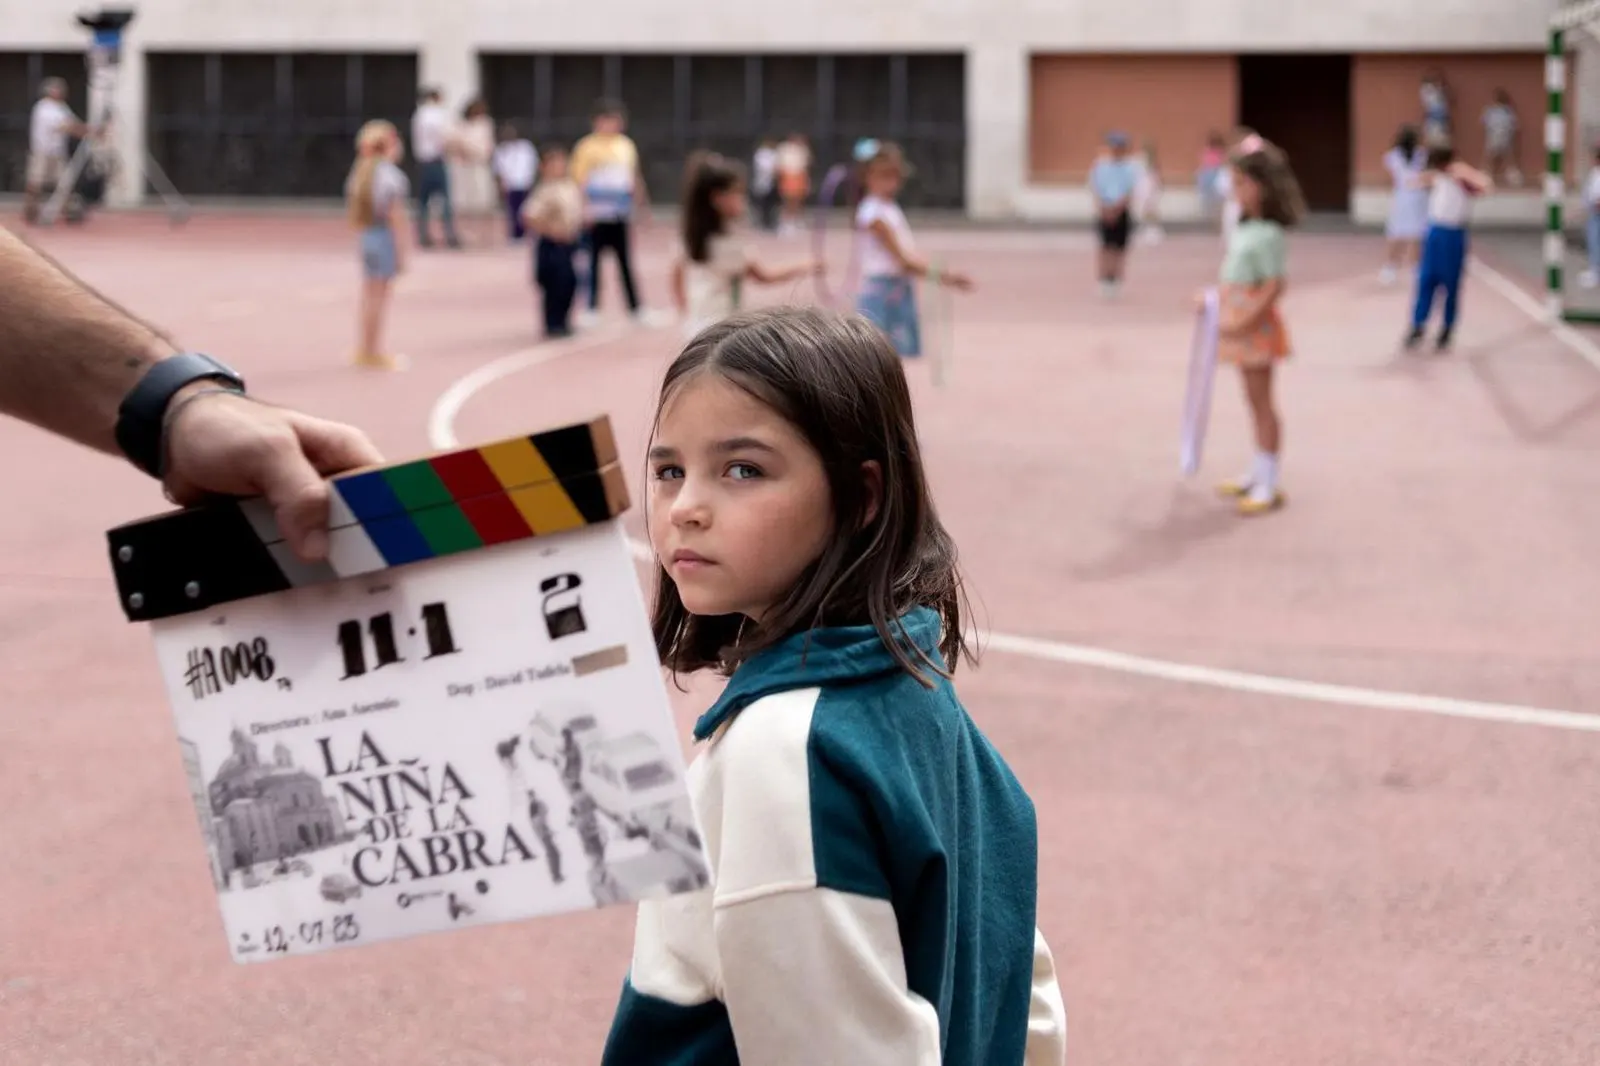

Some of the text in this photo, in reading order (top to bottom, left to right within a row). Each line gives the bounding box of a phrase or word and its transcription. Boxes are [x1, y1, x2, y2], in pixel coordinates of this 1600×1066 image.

[316, 730, 390, 778] LA
[338, 756, 476, 820] NIÑA
[365, 804, 474, 844] DE LA
[352, 823, 538, 888] CABRA
